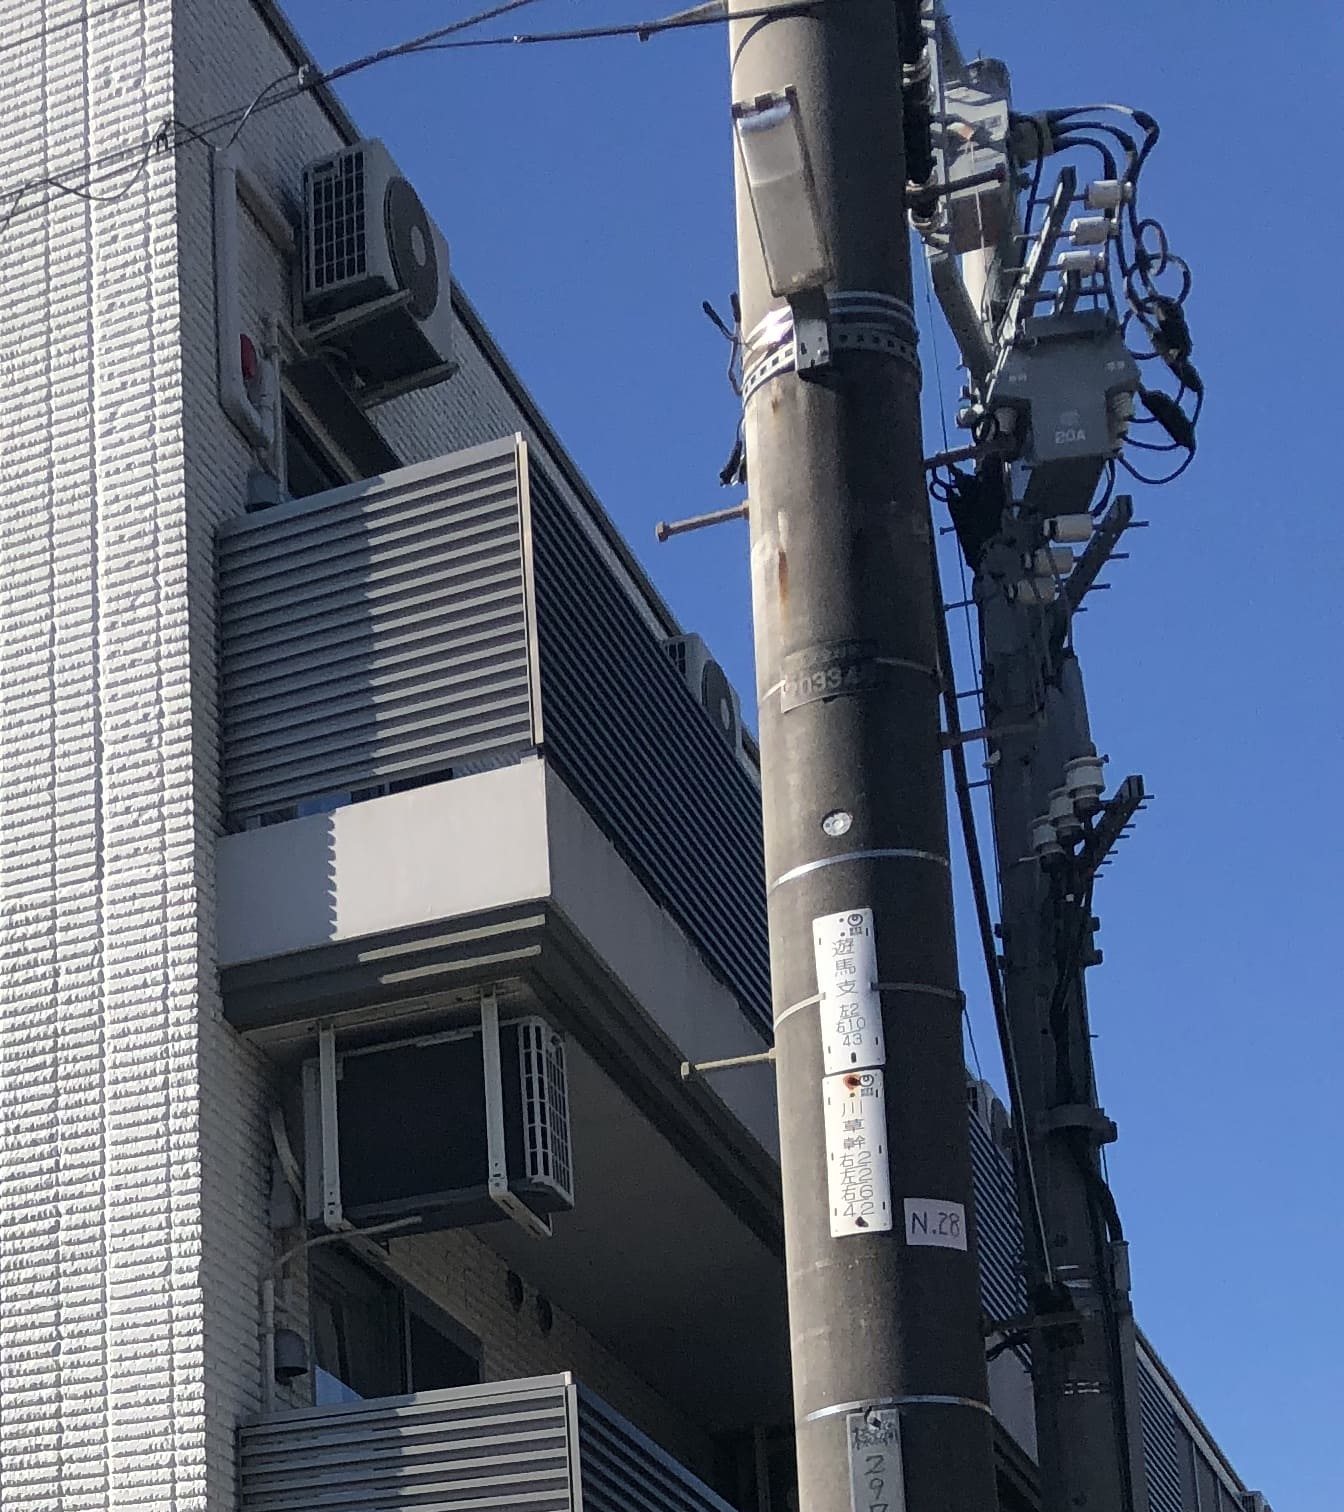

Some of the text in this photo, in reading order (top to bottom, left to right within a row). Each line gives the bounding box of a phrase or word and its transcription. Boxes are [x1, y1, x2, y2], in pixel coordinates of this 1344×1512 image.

[843, 1032, 863, 1047] 43
[843, 1202, 874, 1217] 42
[911, 1211, 960, 1237] N.28
